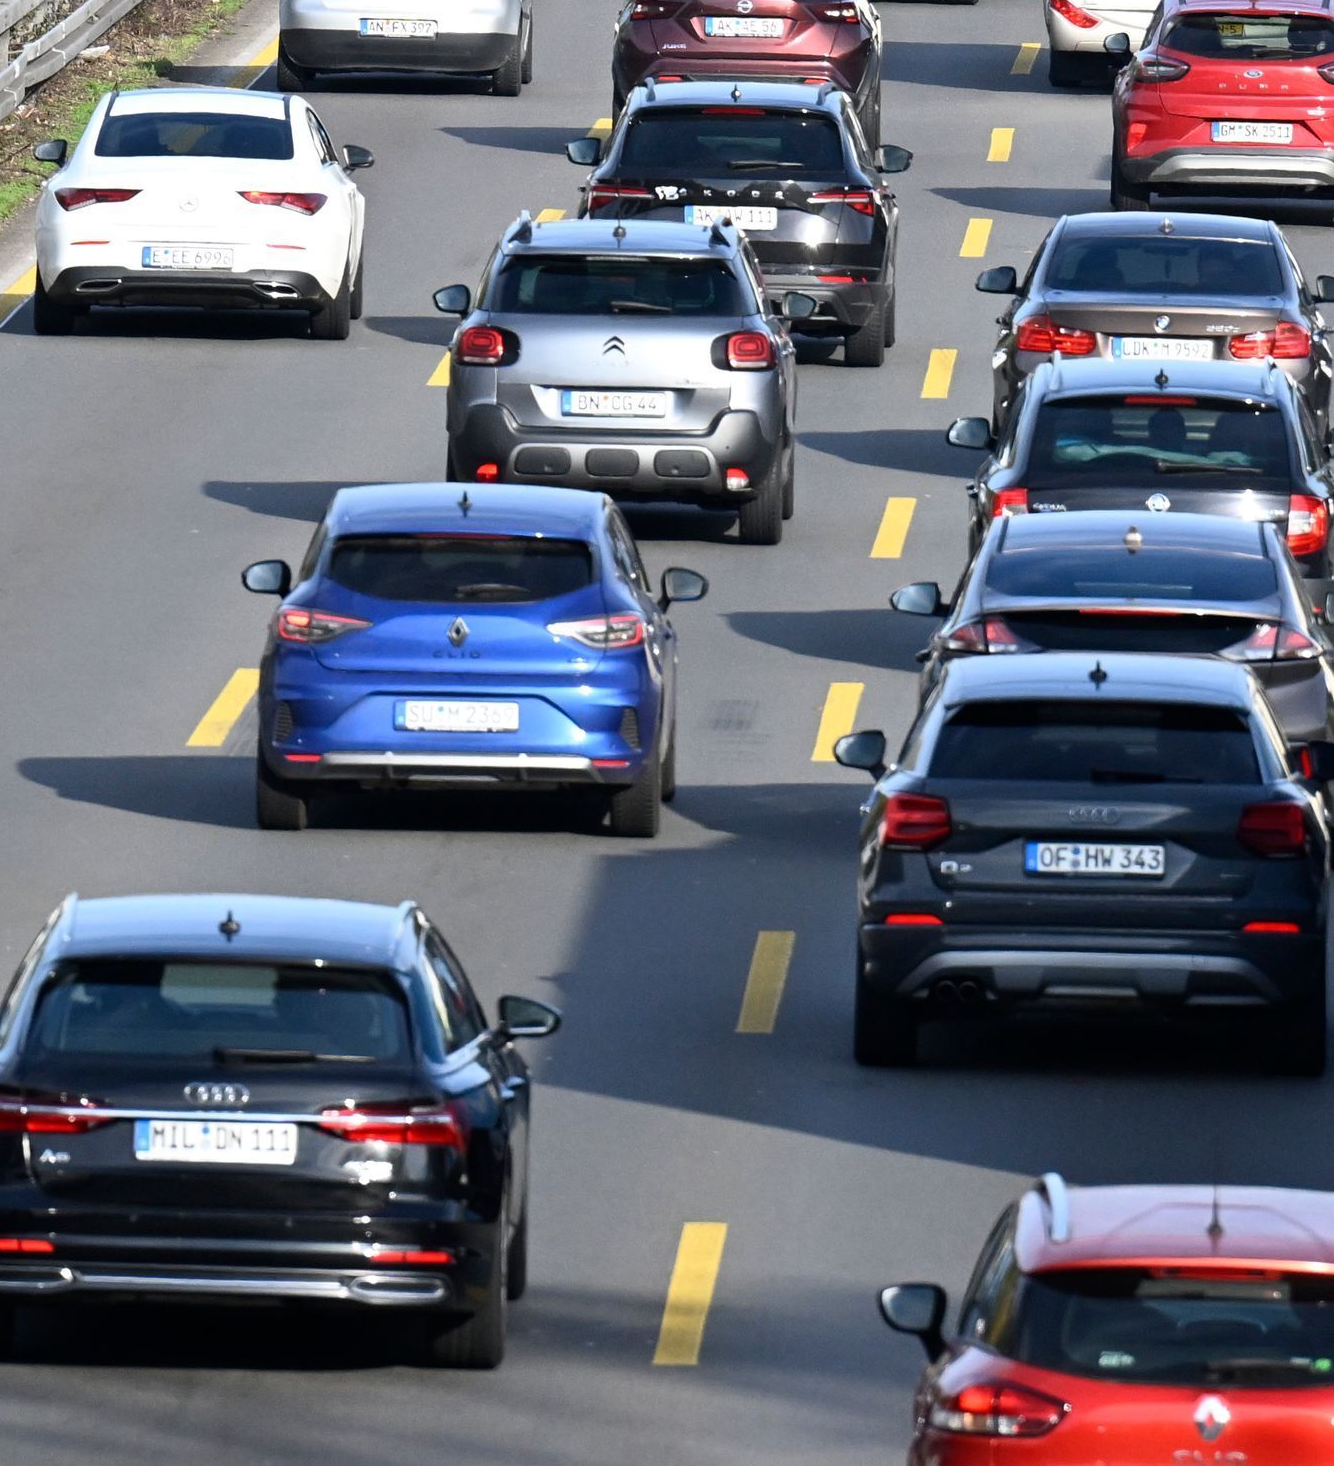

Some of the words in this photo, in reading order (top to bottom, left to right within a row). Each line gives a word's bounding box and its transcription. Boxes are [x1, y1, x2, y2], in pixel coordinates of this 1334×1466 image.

[577, 393, 599, 411] BN
[637, 395, 657, 411] 44
[1039, 844, 1067, 866] OF
[1084, 846, 1113, 868] HW
[1119, 847, 1162, 870] 343
[149, 1123, 193, 1149] MIL
[251, 1126, 291, 1153] 111
